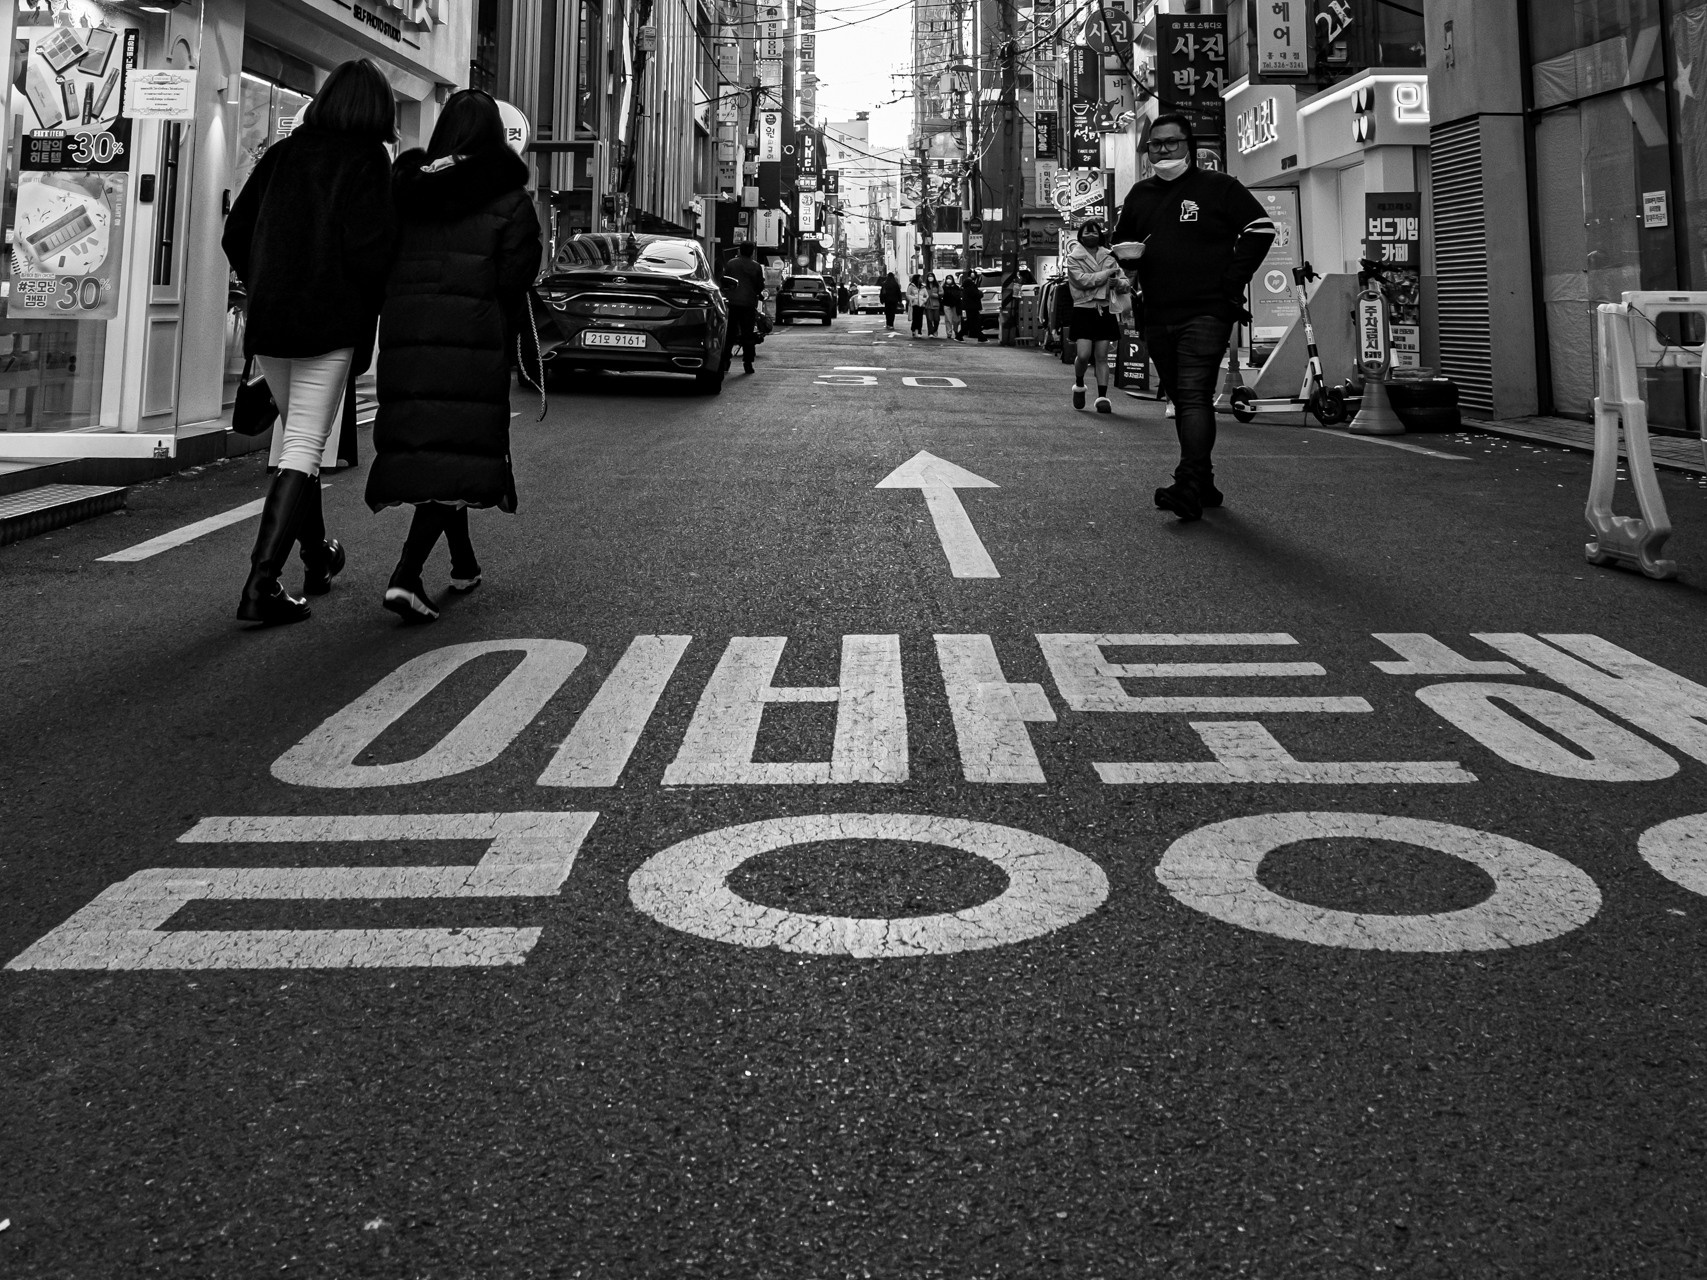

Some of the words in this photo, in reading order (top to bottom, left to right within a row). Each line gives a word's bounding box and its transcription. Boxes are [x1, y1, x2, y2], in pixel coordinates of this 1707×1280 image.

[353, 4, 367, 23] SELF
[366, 12, 384, 33] PHOTO
[383, 21, 402, 43] STUDIO
[1088, 20, 1129, 44] 사진
[1171, 33, 1226, 62] 사진
[1172, 67, 1229, 97] 박사
[1074, 125, 1100, 143] 설빙
[30, 140, 63, 151] 이달의
[804, 135, 814, 167] bhc
[30, 152, 62, 163] 히트템
[1084, 205, 1104, 216] 코인
[1368, 217, 1419, 241] 보드게임
[1381, 243, 1409, 262] 카페
[17, 280, 57, 293] #굿모닝
[25, 294, 47, 307] 캠핑
[1364, 305, 1379, 350] 주차금지
[615, 334, 640, 346] 9161
[1129, 343, 1139, 357] P
[813, 374, 967, 387] 30
[1123, 371, 1145, 379] 주차금지
